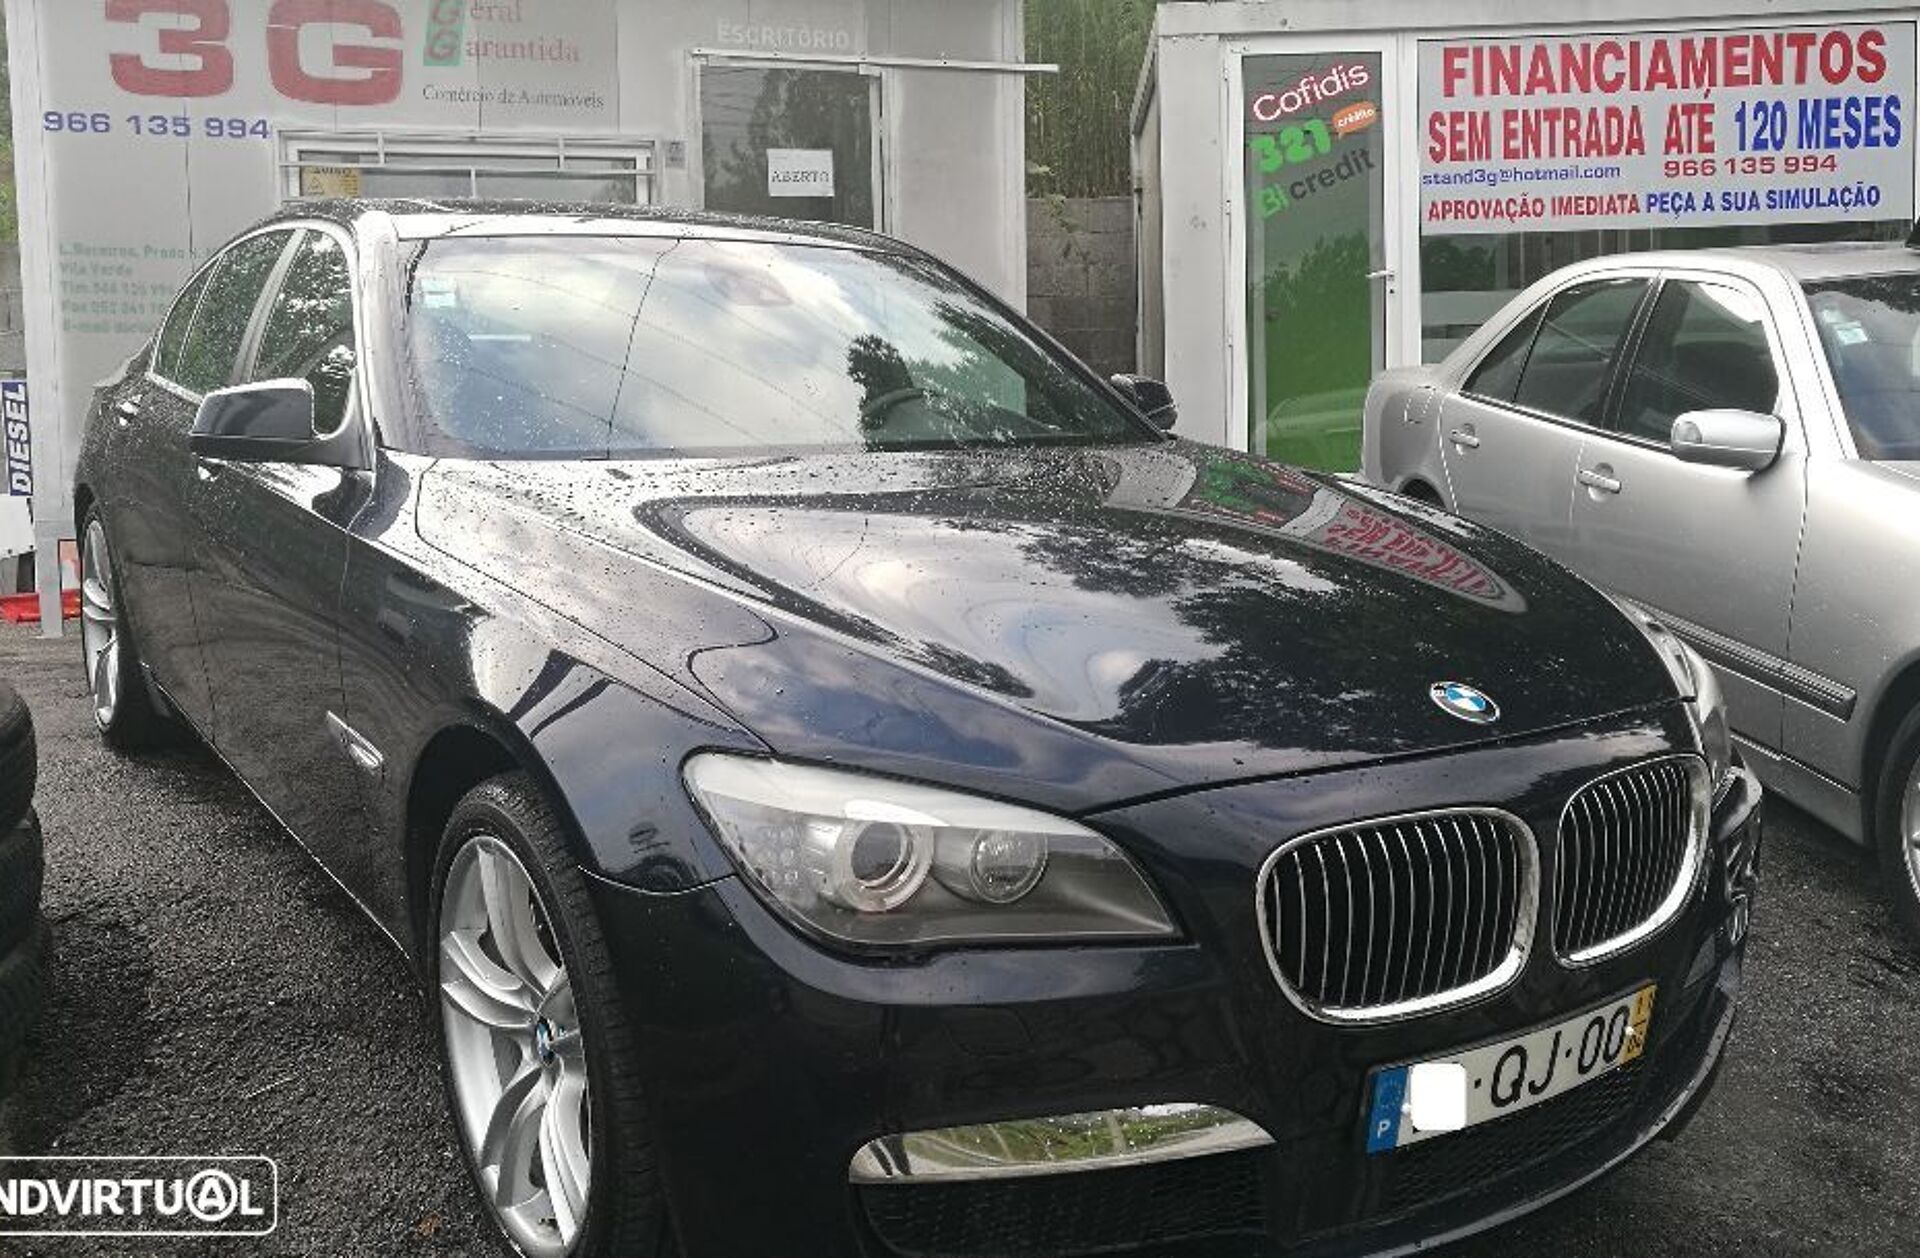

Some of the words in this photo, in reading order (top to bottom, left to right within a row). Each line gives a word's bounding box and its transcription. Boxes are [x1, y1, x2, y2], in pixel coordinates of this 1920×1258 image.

[1443, 30, 1887, 98] FINANCIAMENTOS
[1253, 64, 1369, 121] Cofidis
[43, 111, 111, 133] 966
[126, 115, 192, 137] 135
[205, 117, 269, 139] 994
[1251, 118, 1332, 174] 321
[1429, 111, 1492, 163] SEM
[1503, 104, 1646, 160] ENTRADA
[1663, 89, 1716, 155] ATÉ
[1734, 100, 1787, 151] 120
[1797, 94, 1901, 150] MESES
[771, 170, 830, 183] ABERTO
[1290, 148, 1376, 201] credit
[1422, 164, 1621, 187] stand3g@hotmail.com
[1664, 158, 1717, 178] 966
[1725, 156, 1775, 174] 135
[1784, 154, 1837, 174] 994
[1428, 191, 1545, 223] APROVAÇÃO
[1551, 193, 1641, 217] IMEDIATA
[1646, 190, 1697, 219] PEÇA
[1702, 191, 1716, 213] A
[1721, 189, 1761, 211] SUA
[1766, 181, 1881, 213] SIMULAÇÃO
[4, 383, 33, 495] DIESEL
